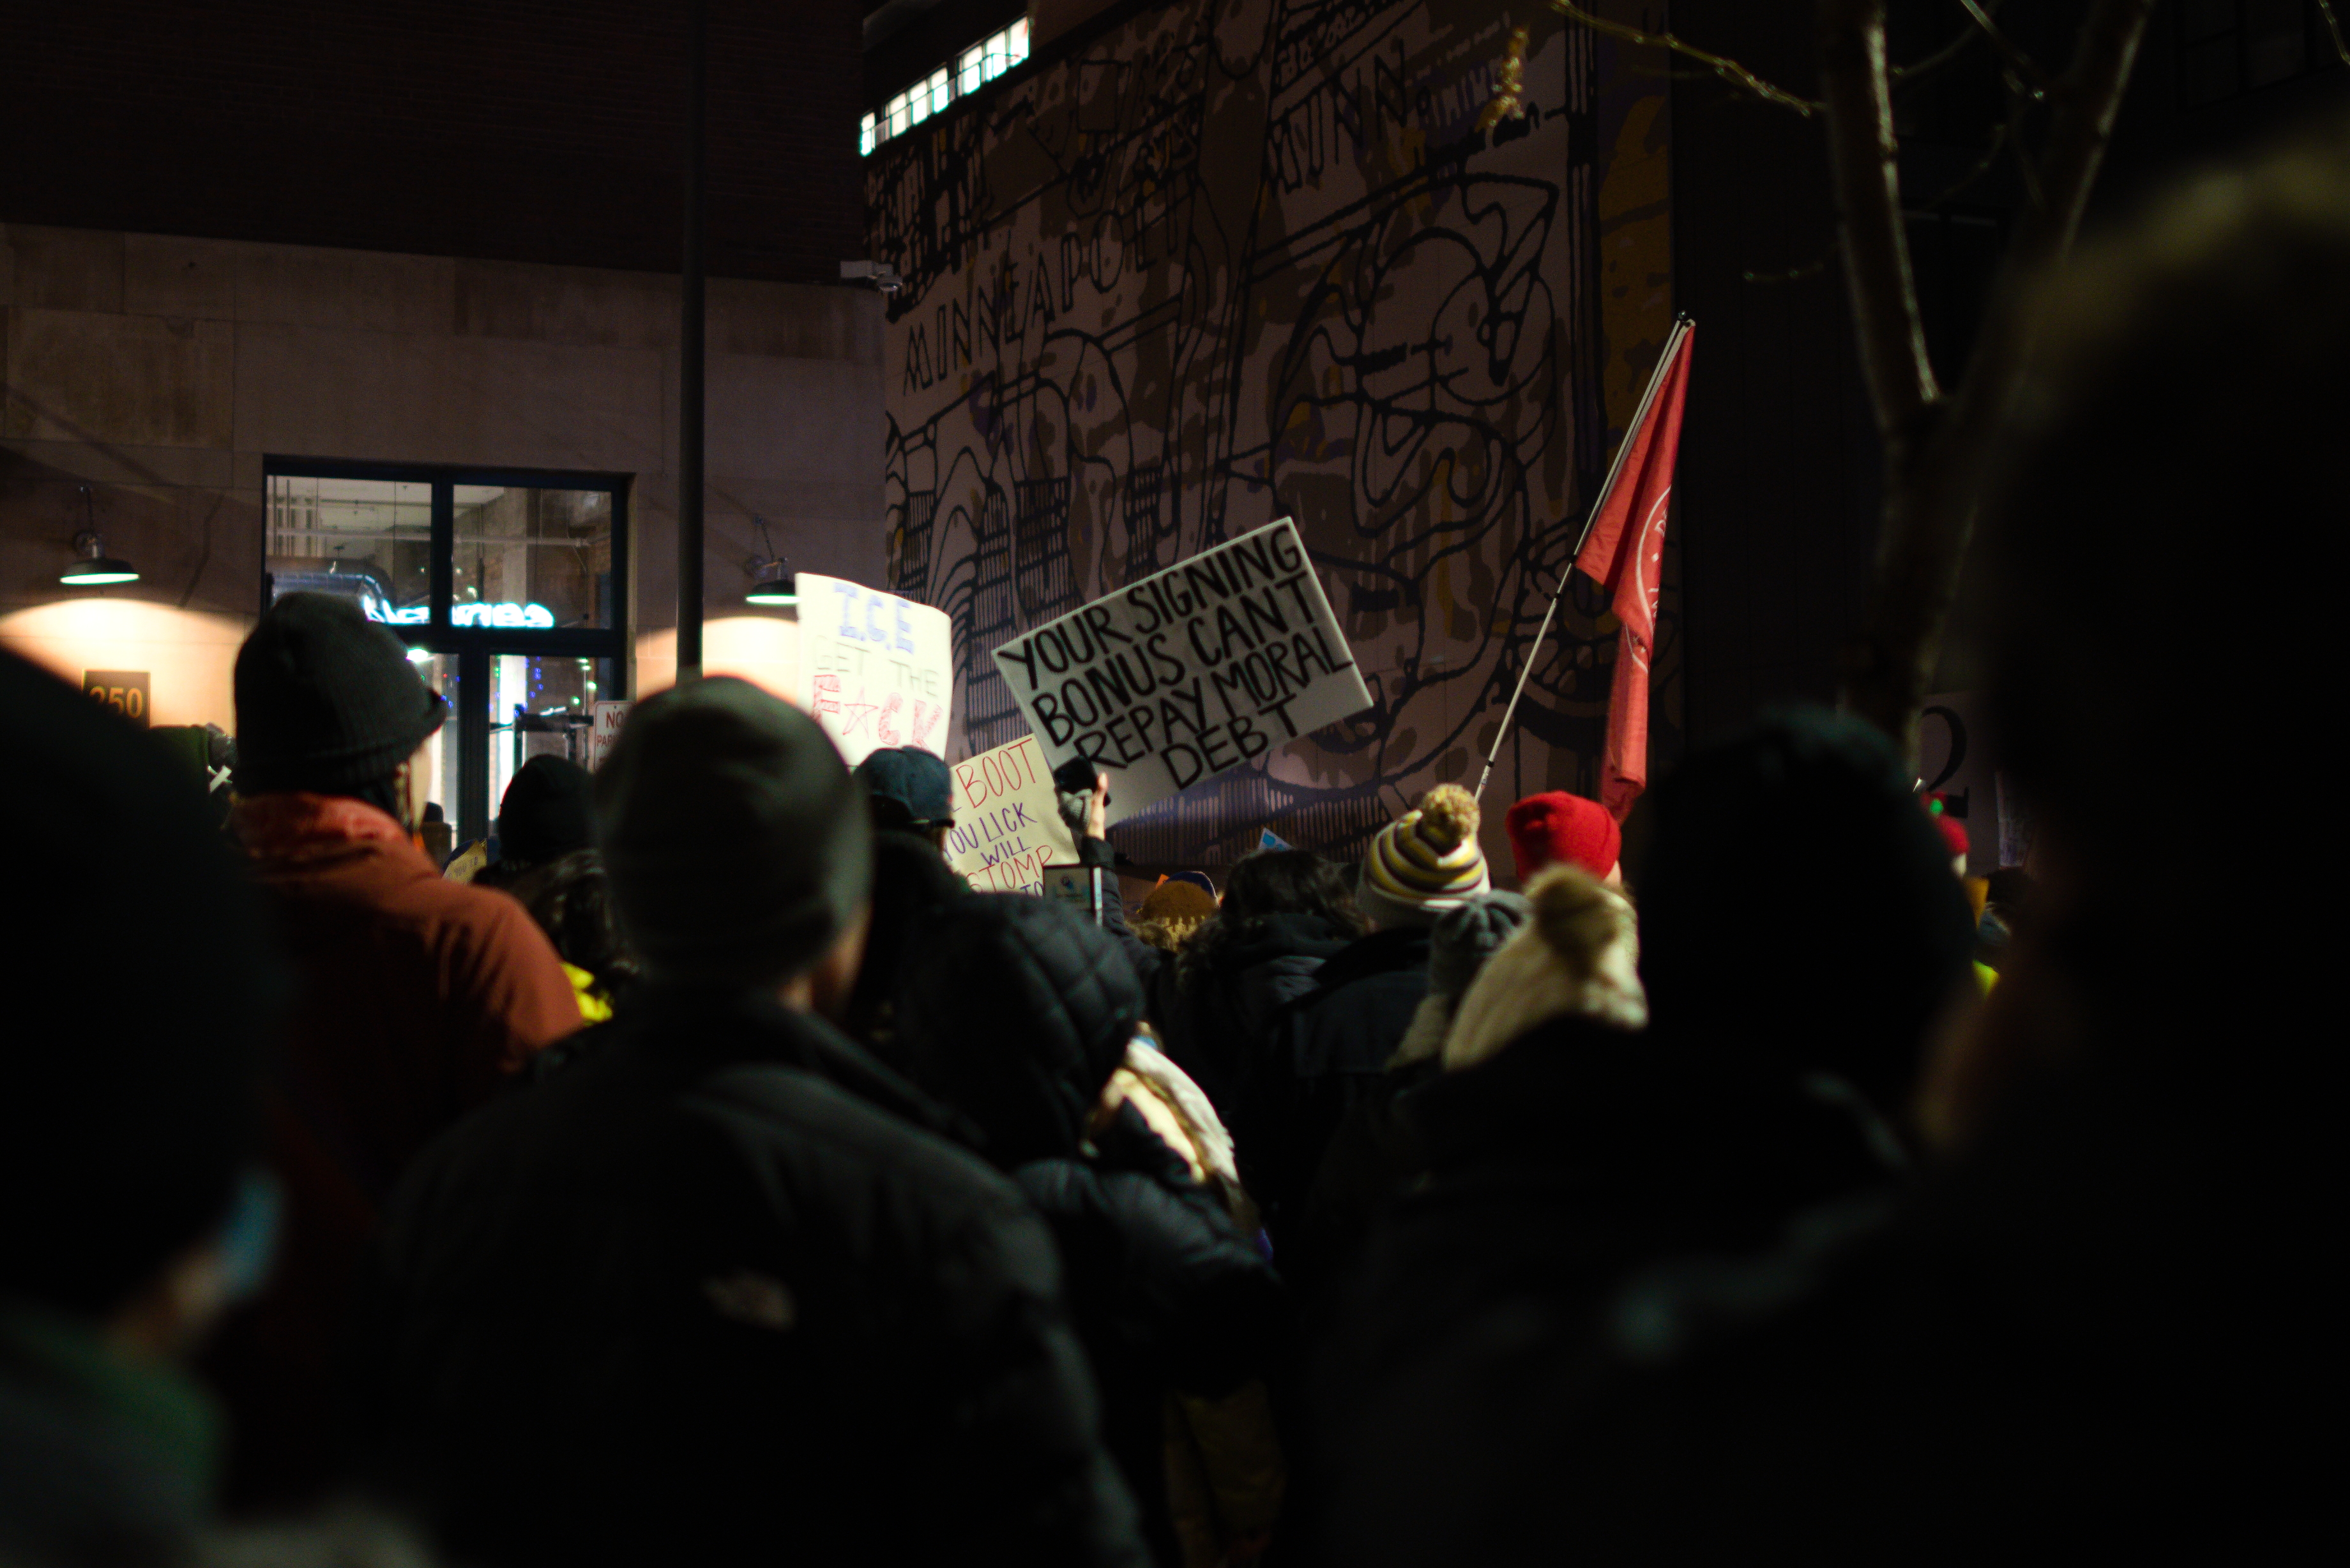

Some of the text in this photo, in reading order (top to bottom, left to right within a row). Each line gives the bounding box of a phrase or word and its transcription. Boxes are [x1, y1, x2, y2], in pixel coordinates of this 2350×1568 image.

[997, 524, 1301, 690] YOUR SIGNING
[812, 635, 939, 698] GET THE
[1031, 571, 1314, 747] BONUS CANT
[606, 711, 625, 728] NO
[1073, 627, 1354, 769] REPAY MORAL
[956, 738, 1036, 809] BOOT
[1160, 693, 1298, 790] DEBT
[978, 802, 1038, 842] LICK
[980, 836, 1032, 865] WILL
[966, 845, 1052, 893] STOMP
